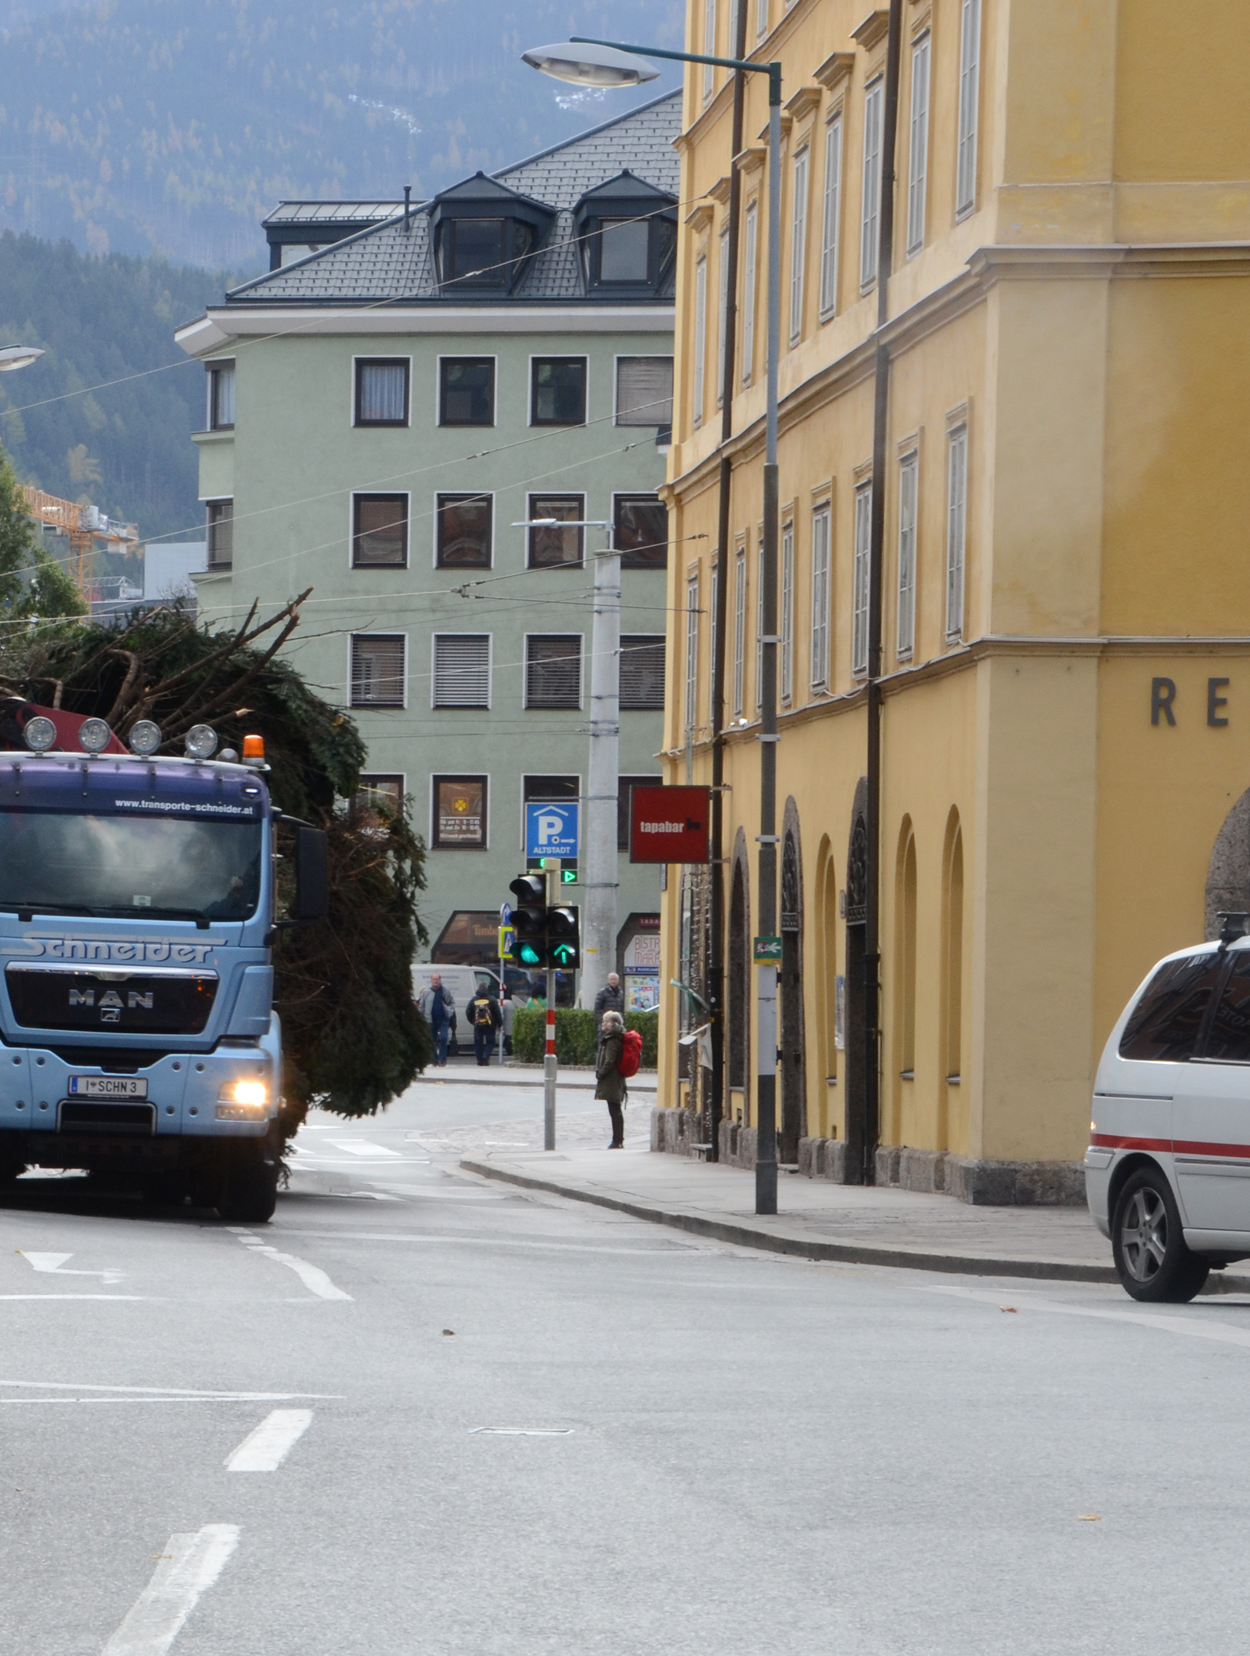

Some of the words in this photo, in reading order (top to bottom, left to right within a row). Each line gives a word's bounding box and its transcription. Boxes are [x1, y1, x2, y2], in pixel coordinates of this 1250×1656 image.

[1150, 677, 1230, 727] RE
[115, 798, 254, 815] www.transporte-schneider.at
[538, 815, 564, 845] P
[640, 820, 685, 834] tapabar
[0, 931, 228, 963] Schneider
[635, 935, 660, 950] BISTR
[69, 988, 154, 1009] MAN
[98, 1080, 128, 1093] SCHN
